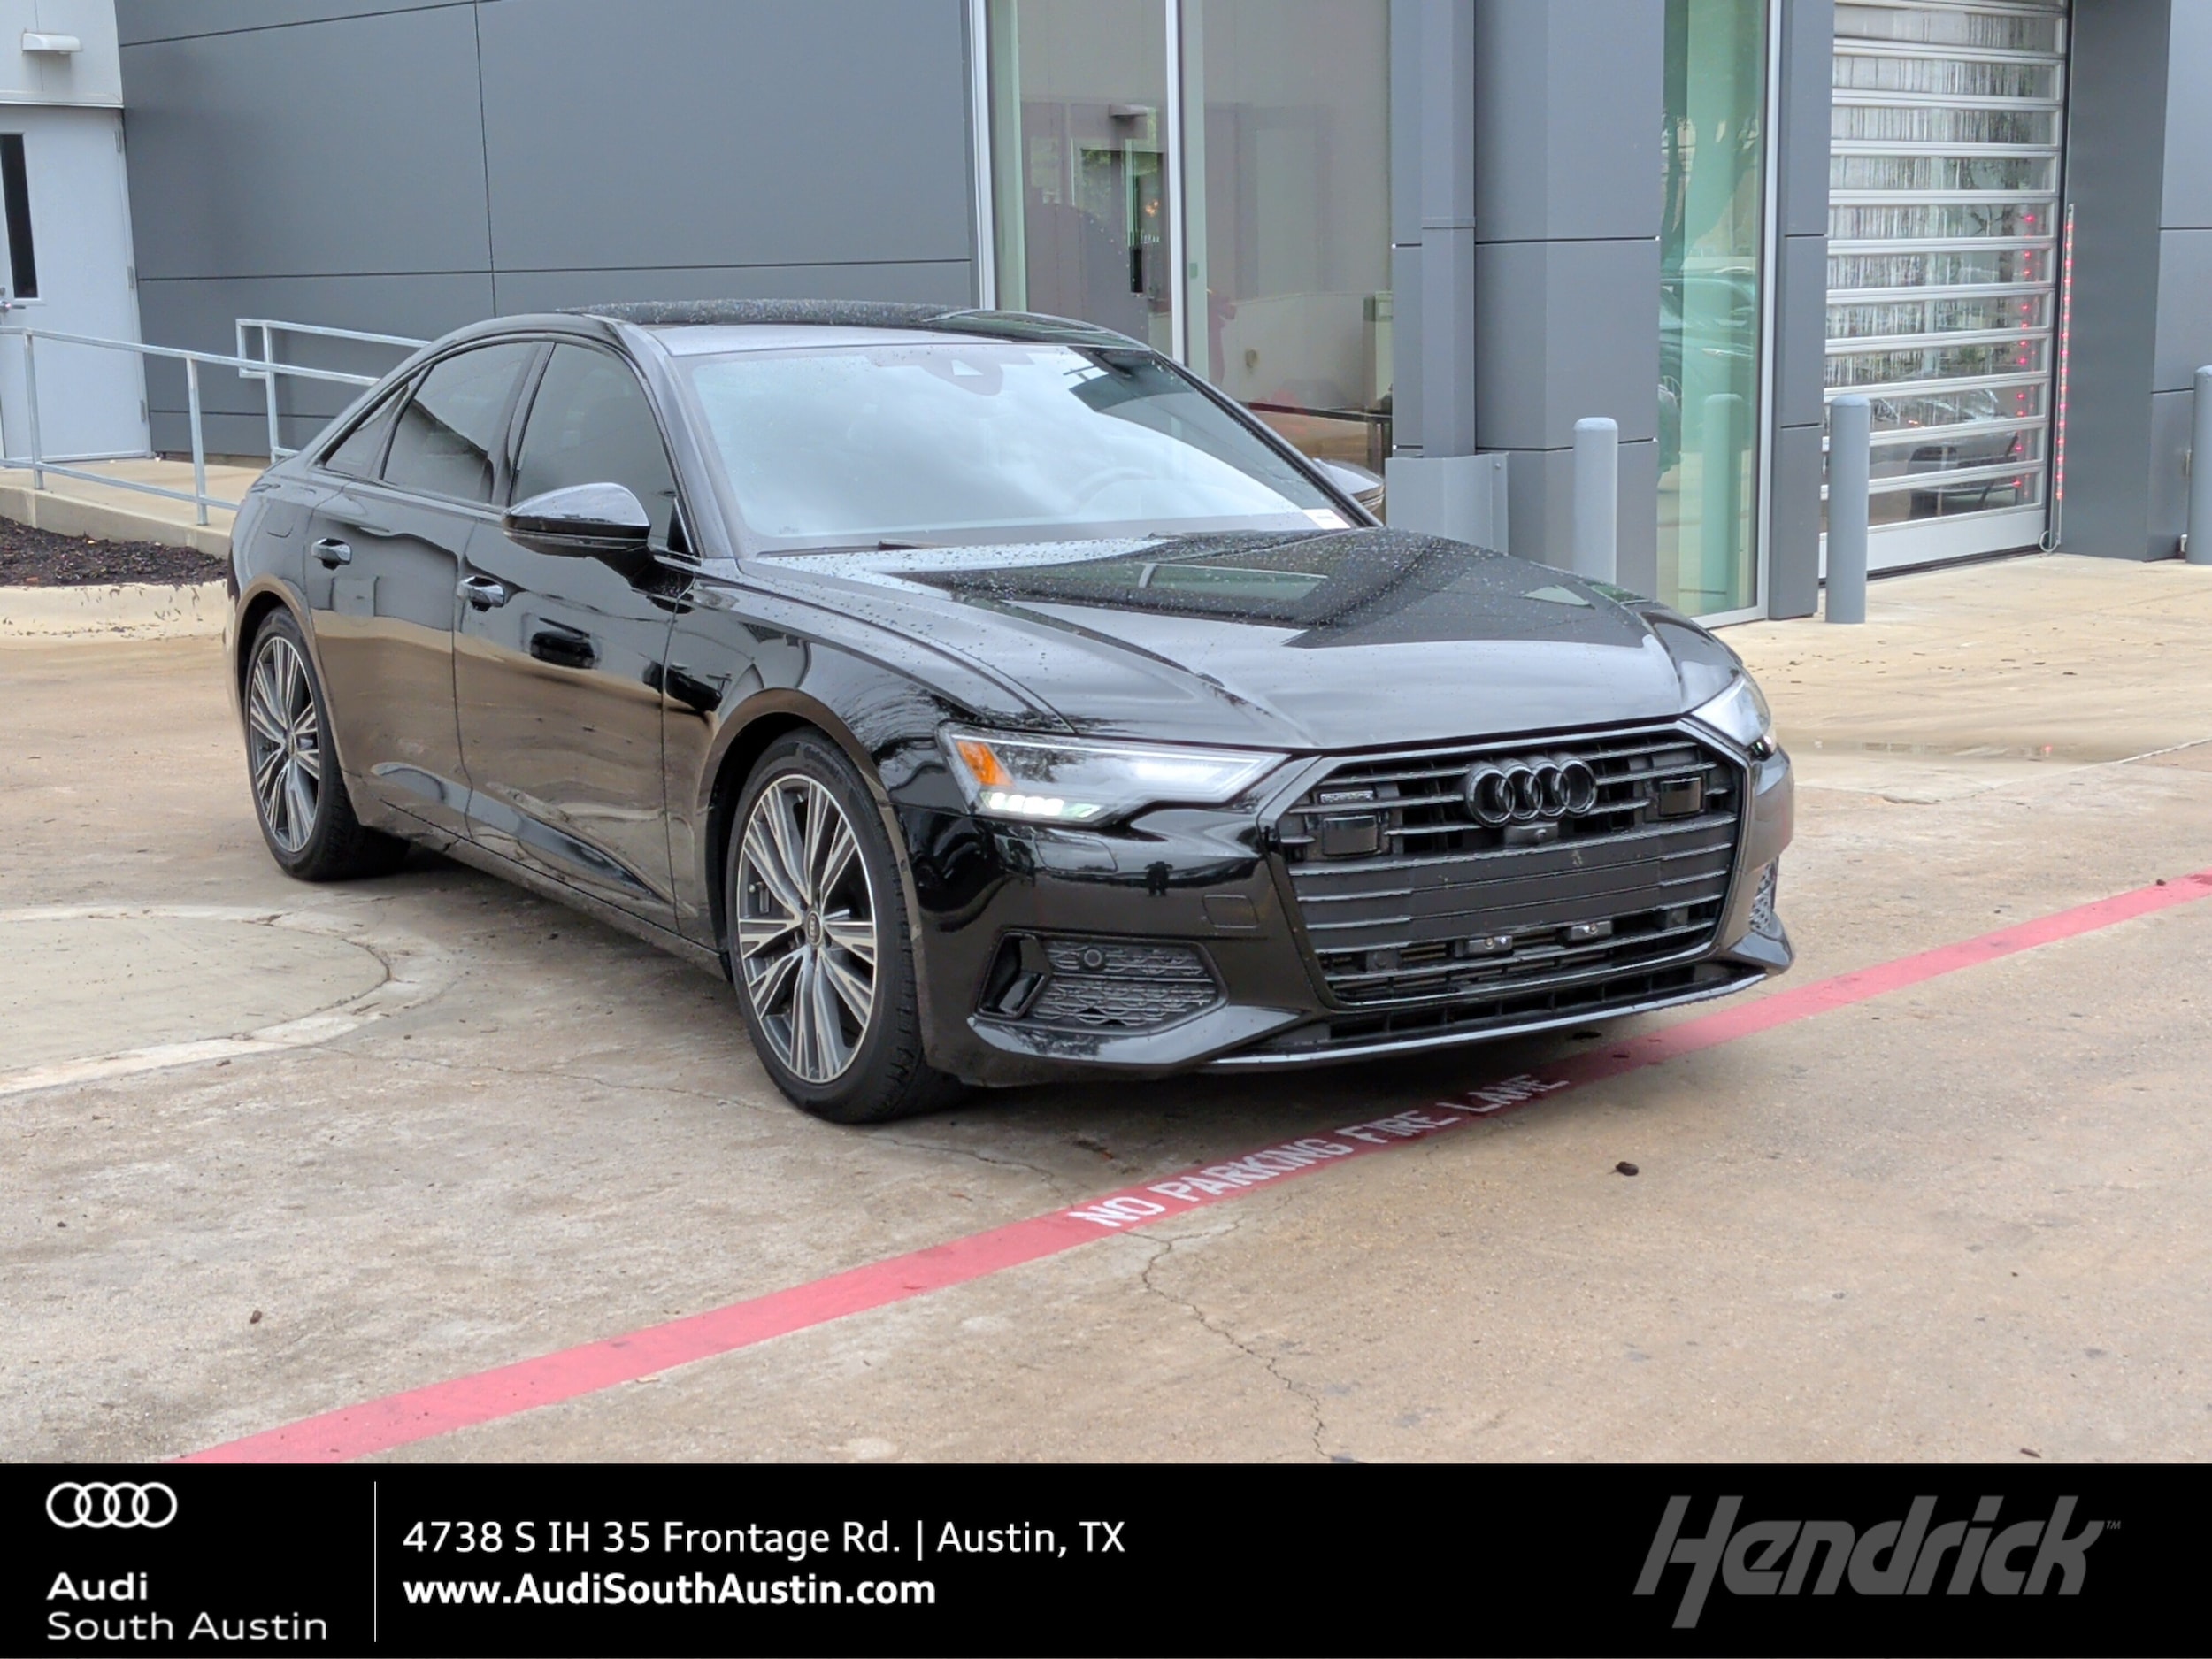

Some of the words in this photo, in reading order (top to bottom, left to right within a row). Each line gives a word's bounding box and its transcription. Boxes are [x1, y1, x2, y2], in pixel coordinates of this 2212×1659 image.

[1067, 1196, 1165, 1227] NO
[1147, 1138, 1354, 1202] PARKING
[1334, 1110, 1461, 1143] FIRE
[1435, 1073, 1570, 1112] LANE
